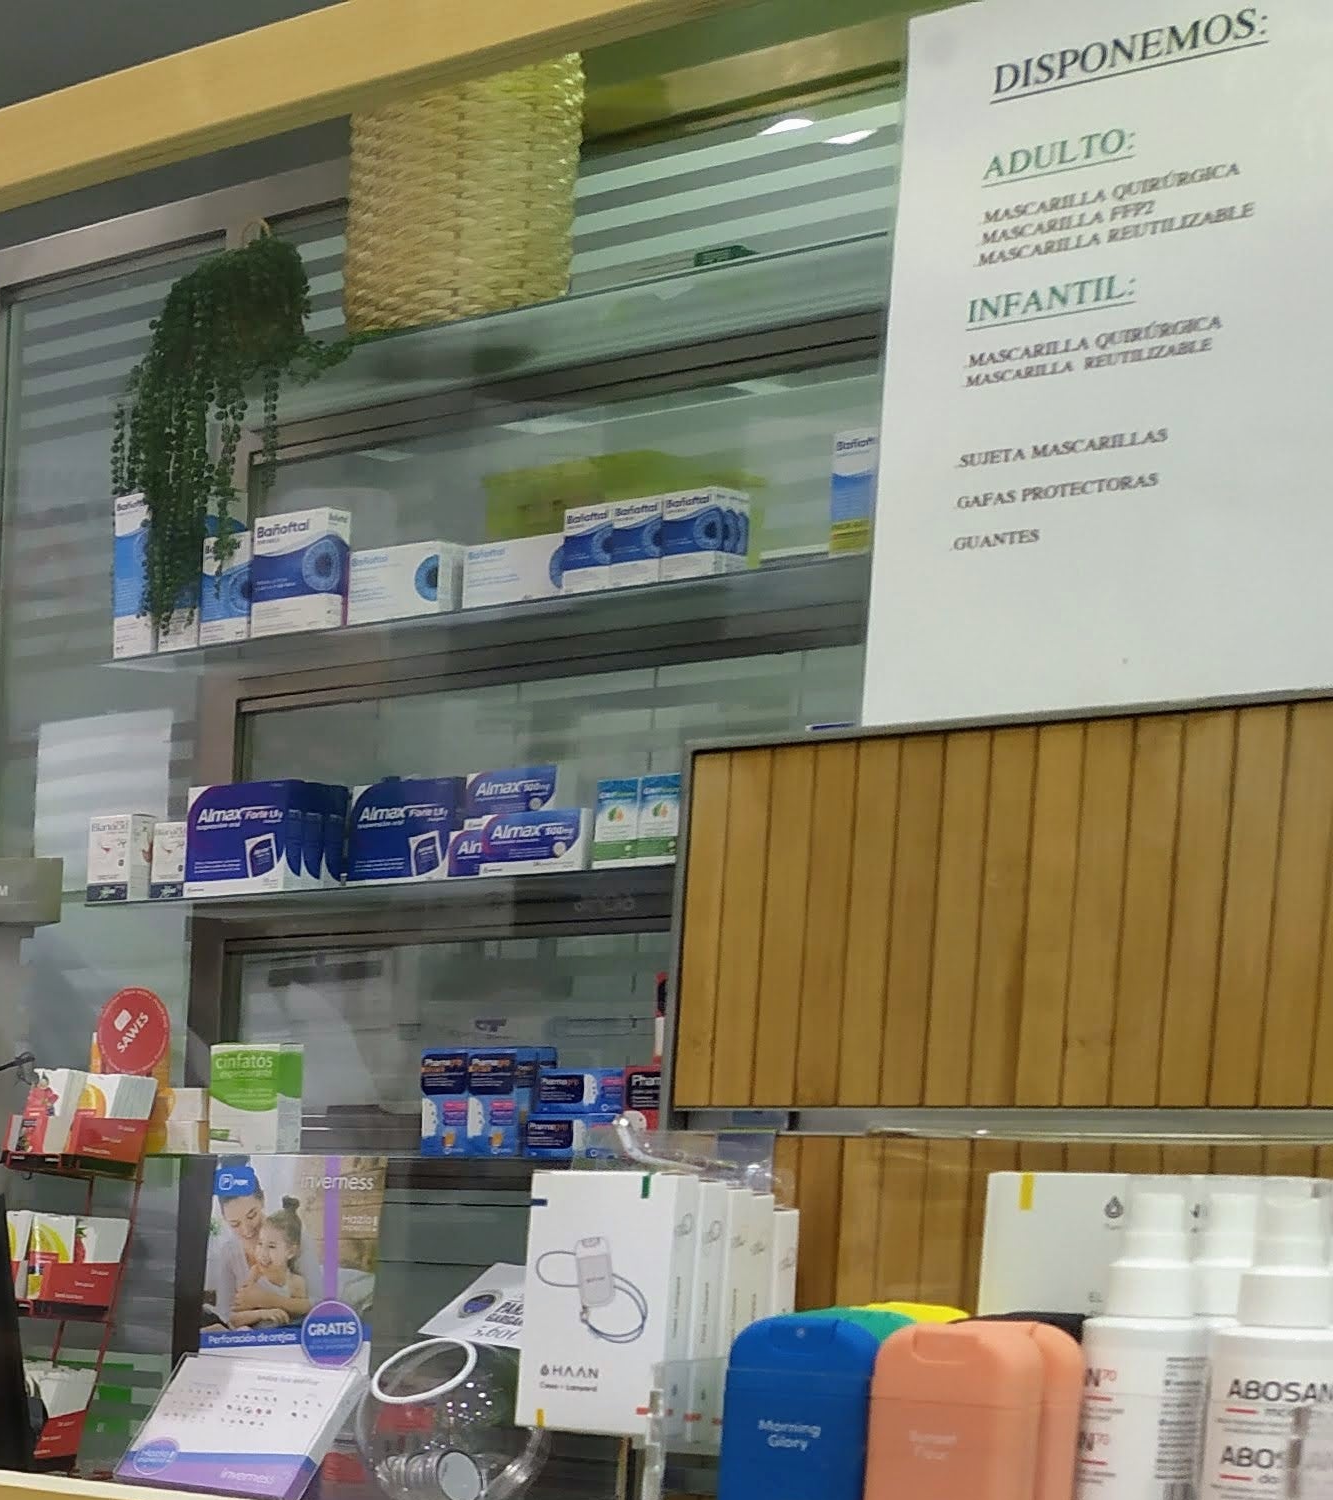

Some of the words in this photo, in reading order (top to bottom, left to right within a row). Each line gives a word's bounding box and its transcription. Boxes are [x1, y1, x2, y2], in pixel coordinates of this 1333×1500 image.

[993, 8, 1268, 95] DISPONEMOS:
[983, 128, 1136, 181] ADULTO:
[1109, 199, 1156, 223] FFP2
[1106, 202, 1256, 244] REUTILIZABLE
[967, 274, 1137, 324] INFANTIL:
[1083, 337, 1213, 370] REUTILIZABLE
[1031, 427, 1170, 460] MASCARILLAS
[1021, 472, 1160, 503] PROTECTORAS
[256, 518, 310, 539] Bañoftal
[475, 781, 520, 798] Almax
[197, 807, 242, 824] Almax
[359, 806, 405, 823] Almax
[490, 825, 540, 841] Almax
[116, 1011, 149, 1054] SAWES
[215, 1051, 273, 1069] cinfatós
[307, 1321, 357, 1337] GRATIS
[758, 1418, 822, 1438] Morning
[767, 1434, 809, 1451] Glory
